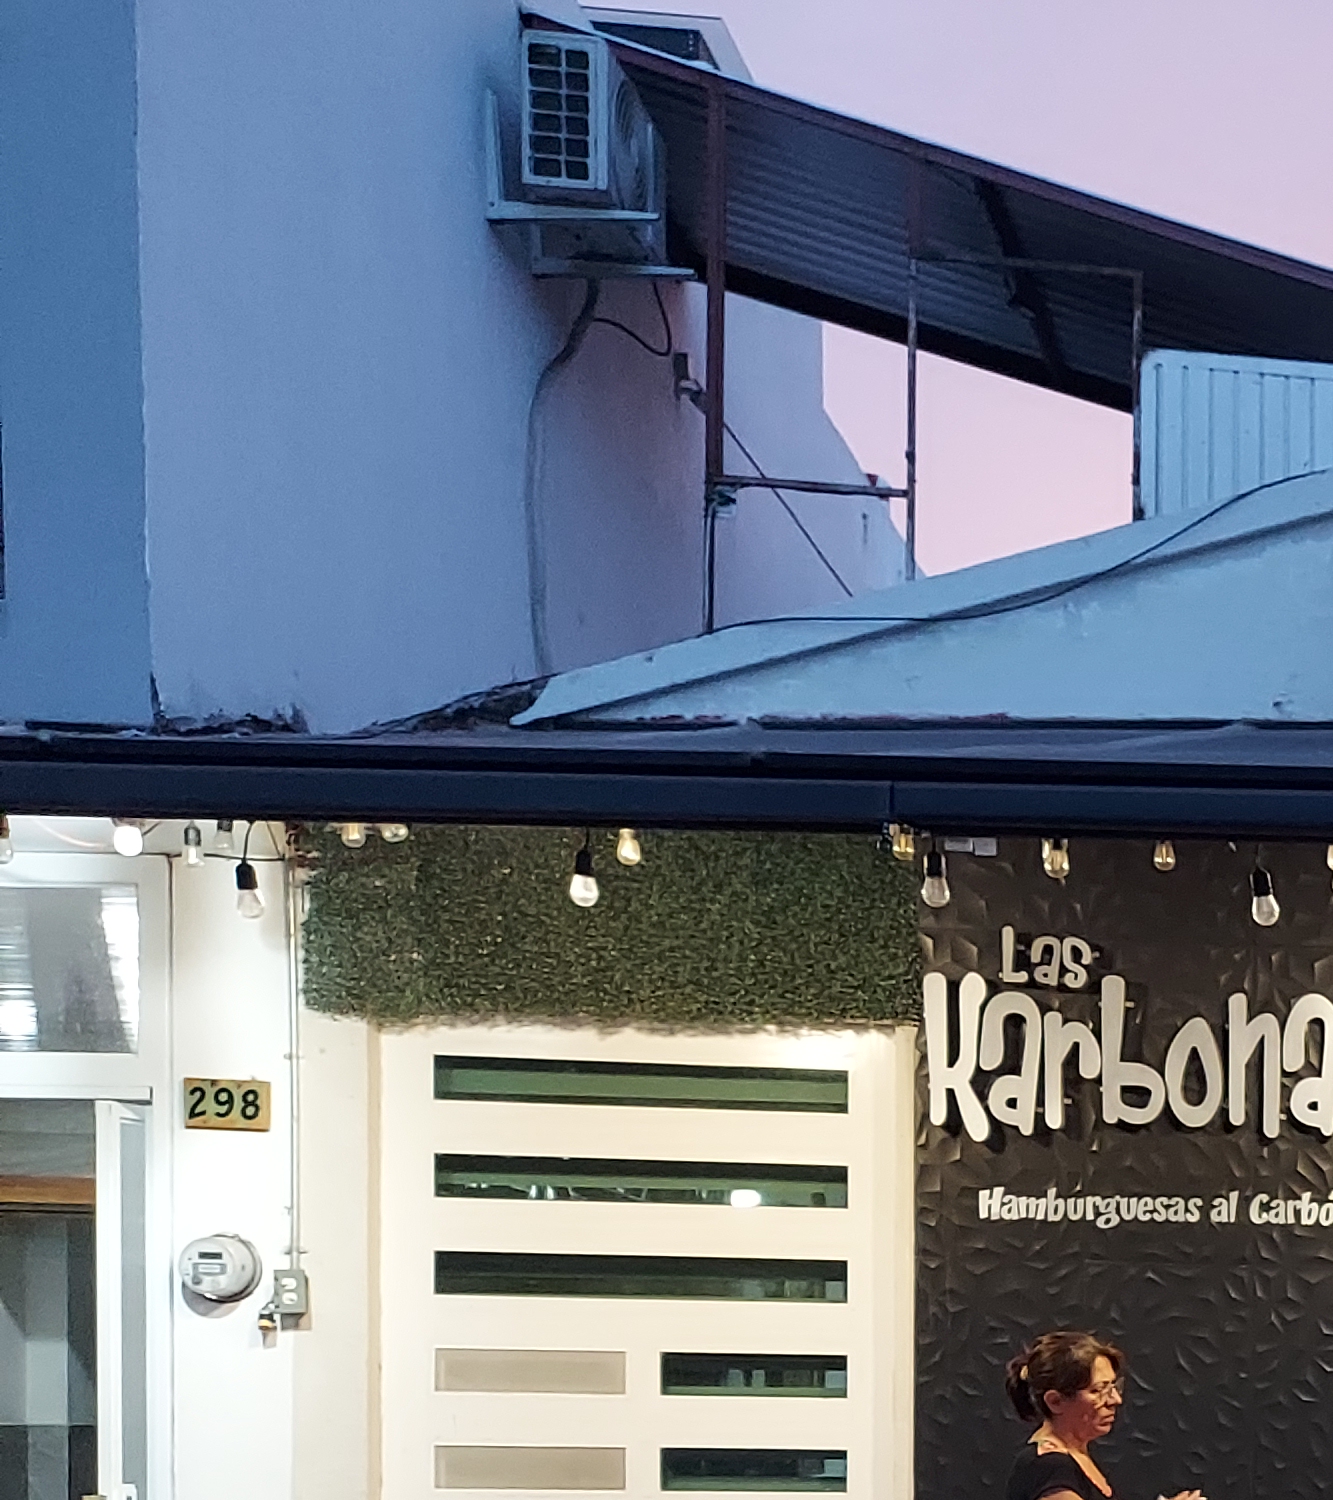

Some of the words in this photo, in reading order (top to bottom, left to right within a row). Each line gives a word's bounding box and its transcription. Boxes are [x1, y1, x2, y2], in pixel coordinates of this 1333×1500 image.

[1000, 925, 1092, 989] Las
[188, 1086, 260, 1120] 298
[977, 1186, 1203, 1229] Hamburguesas
[1210, 1189, 1240, 1223] al
